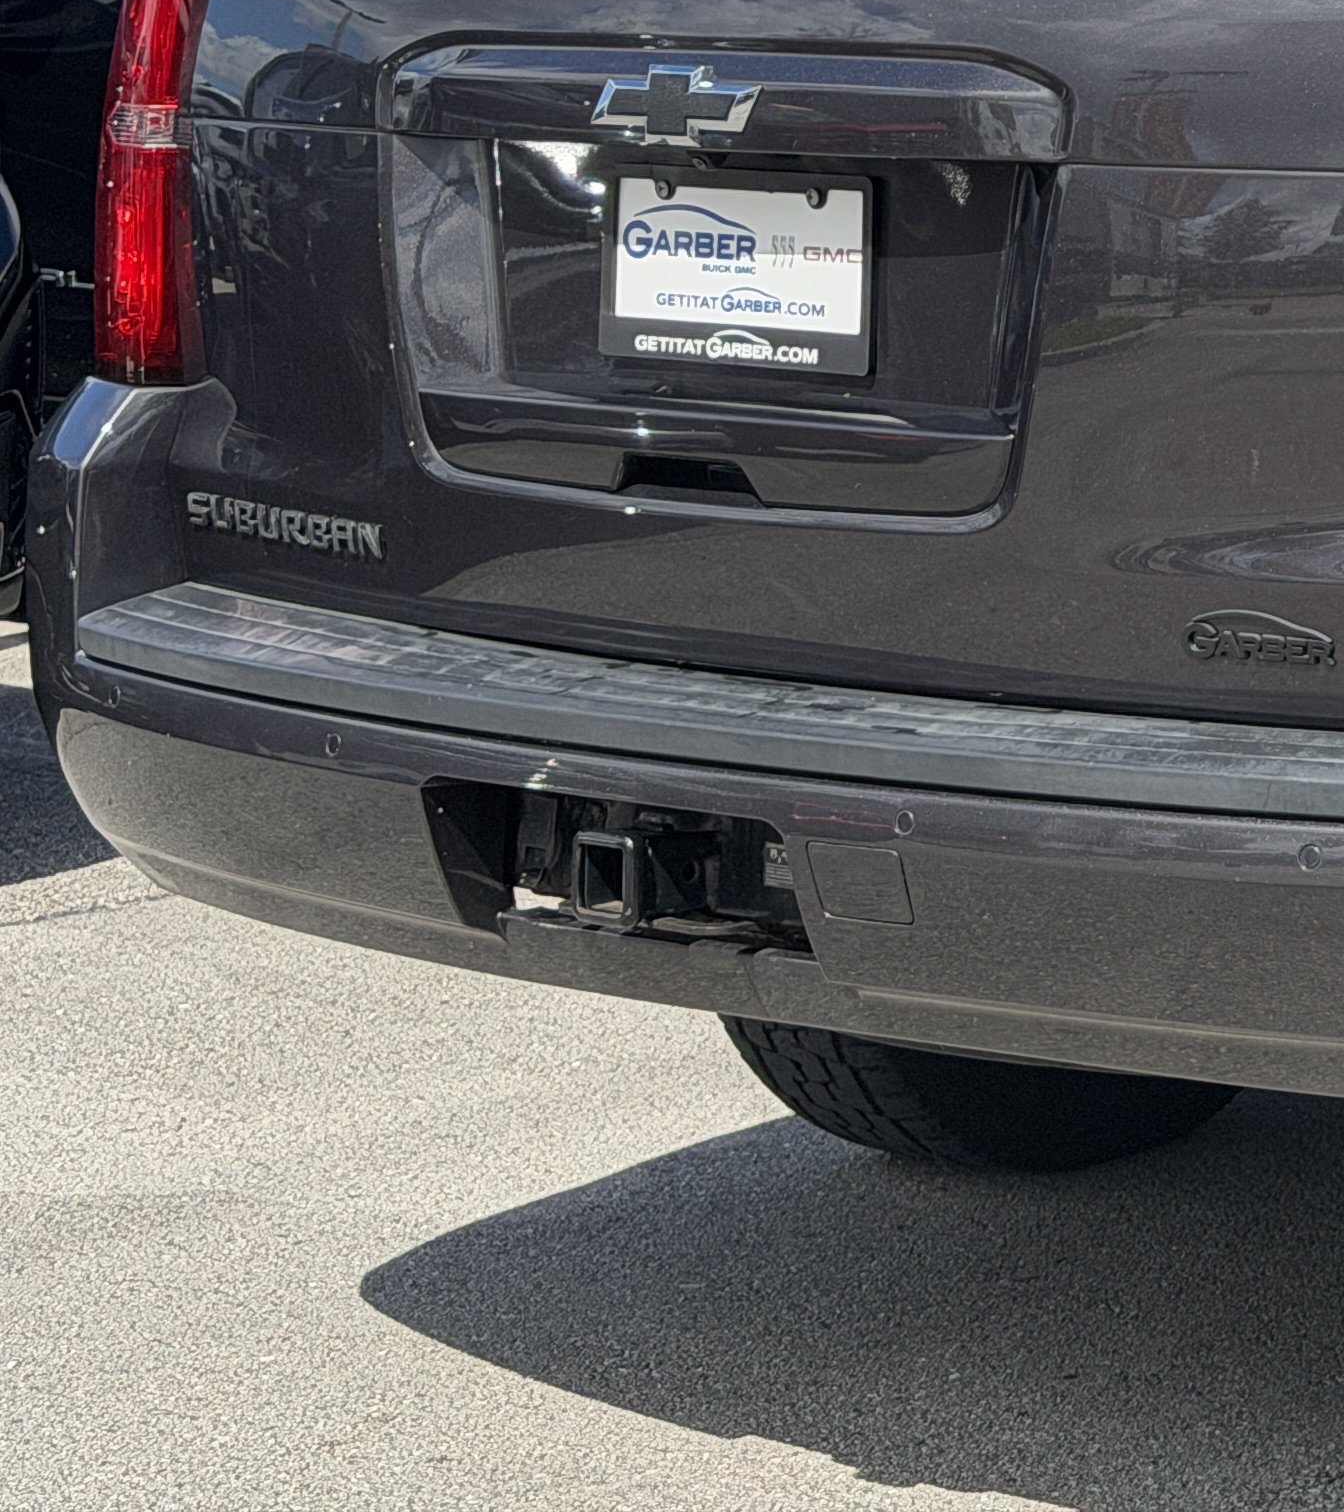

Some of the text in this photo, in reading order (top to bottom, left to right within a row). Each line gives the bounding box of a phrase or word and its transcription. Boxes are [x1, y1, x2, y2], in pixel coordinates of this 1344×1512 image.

[622, 219, 757, 263] GARBER
[803, 245, 863, 264] GMC
[701, 263, 757, 276] BUICK GMC
[186, 491, 385, 561] SUBURBAN
[1182, 621, 1338, 666] GARBER
